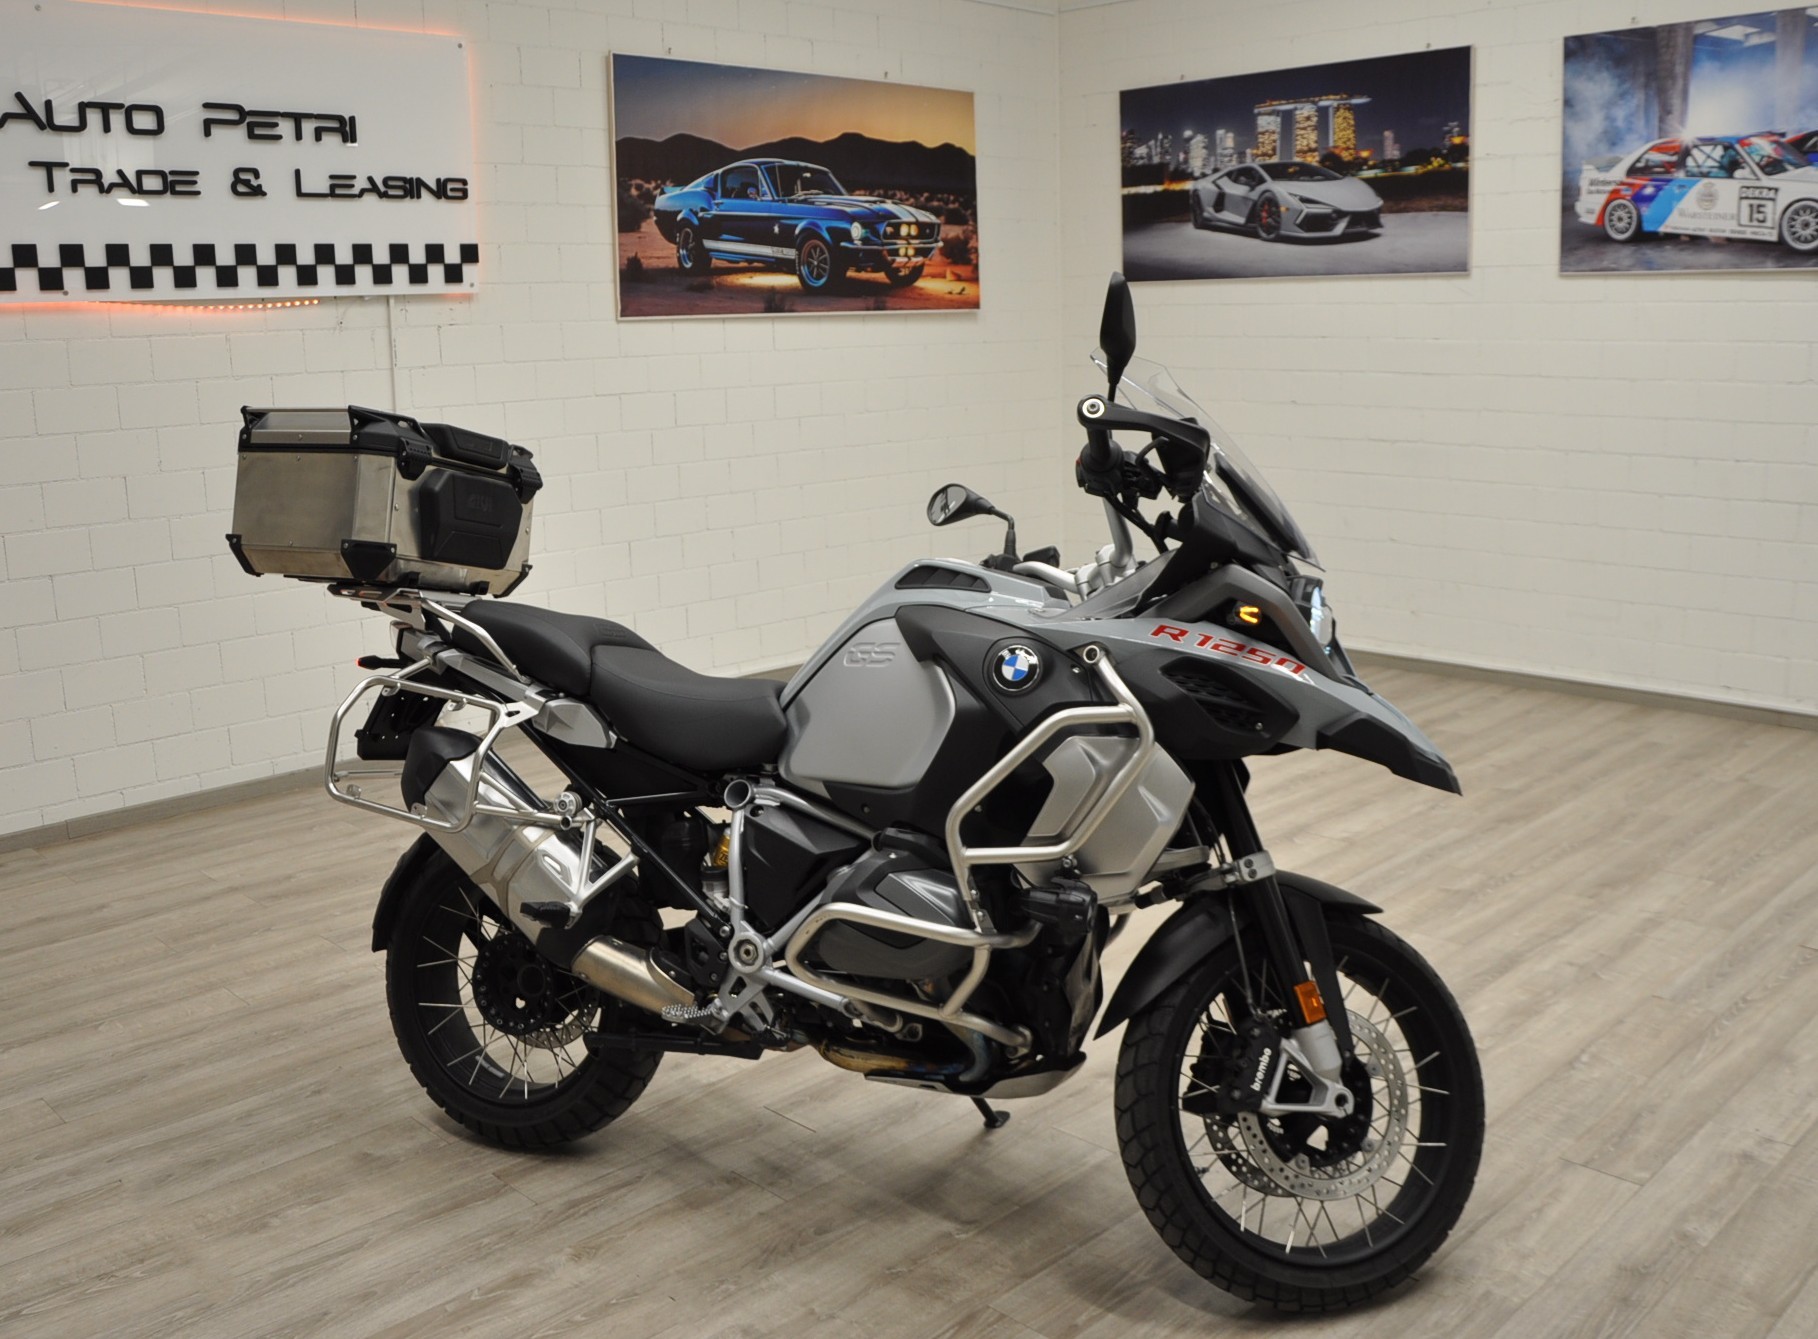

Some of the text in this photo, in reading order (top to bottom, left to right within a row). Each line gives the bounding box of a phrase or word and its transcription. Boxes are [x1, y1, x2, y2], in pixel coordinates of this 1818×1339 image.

[202, 101, 358, 144] PETRI
[28, 161, 469, 200] TRADE & LEASING
[1747, 203, 1767, 223] 15
[1150, 624, 1189, 644] R
[843, 642, 901, 668] GS
[1250, 1047, 1272, 1091] brembo
